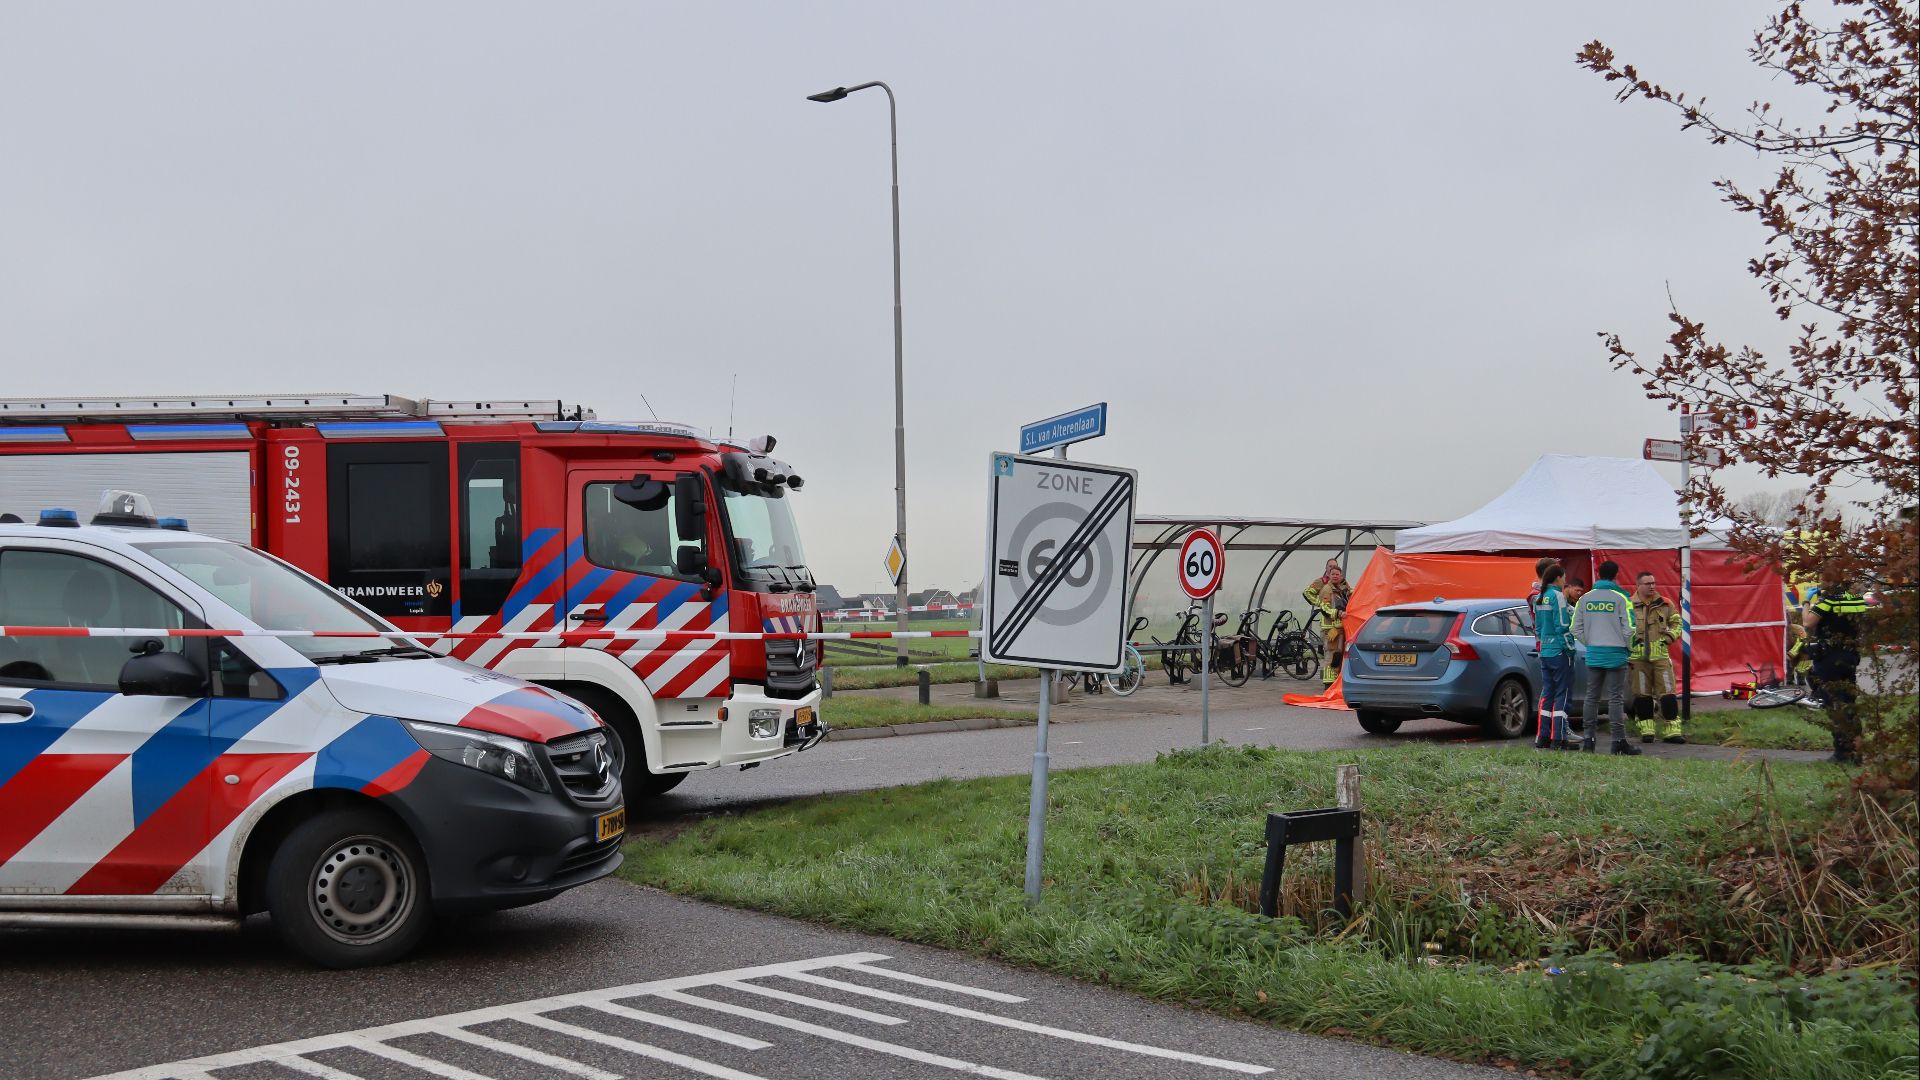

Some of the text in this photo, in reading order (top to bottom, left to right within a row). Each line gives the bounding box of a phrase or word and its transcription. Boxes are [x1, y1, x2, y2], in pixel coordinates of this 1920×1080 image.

[1025, 417, 1095, 446] S.L. van Alterenlaan
[284, 445, 301, 523] 09-2431
[1036, 471, 1093, 494] ZONE
[1027, 539, 1093, 587] 60
[1186, 550, 1213, 577] 60
[1586, 602, 1614, 611] OvDG
[1382, 654, 1412, 663] KJ-333-J
